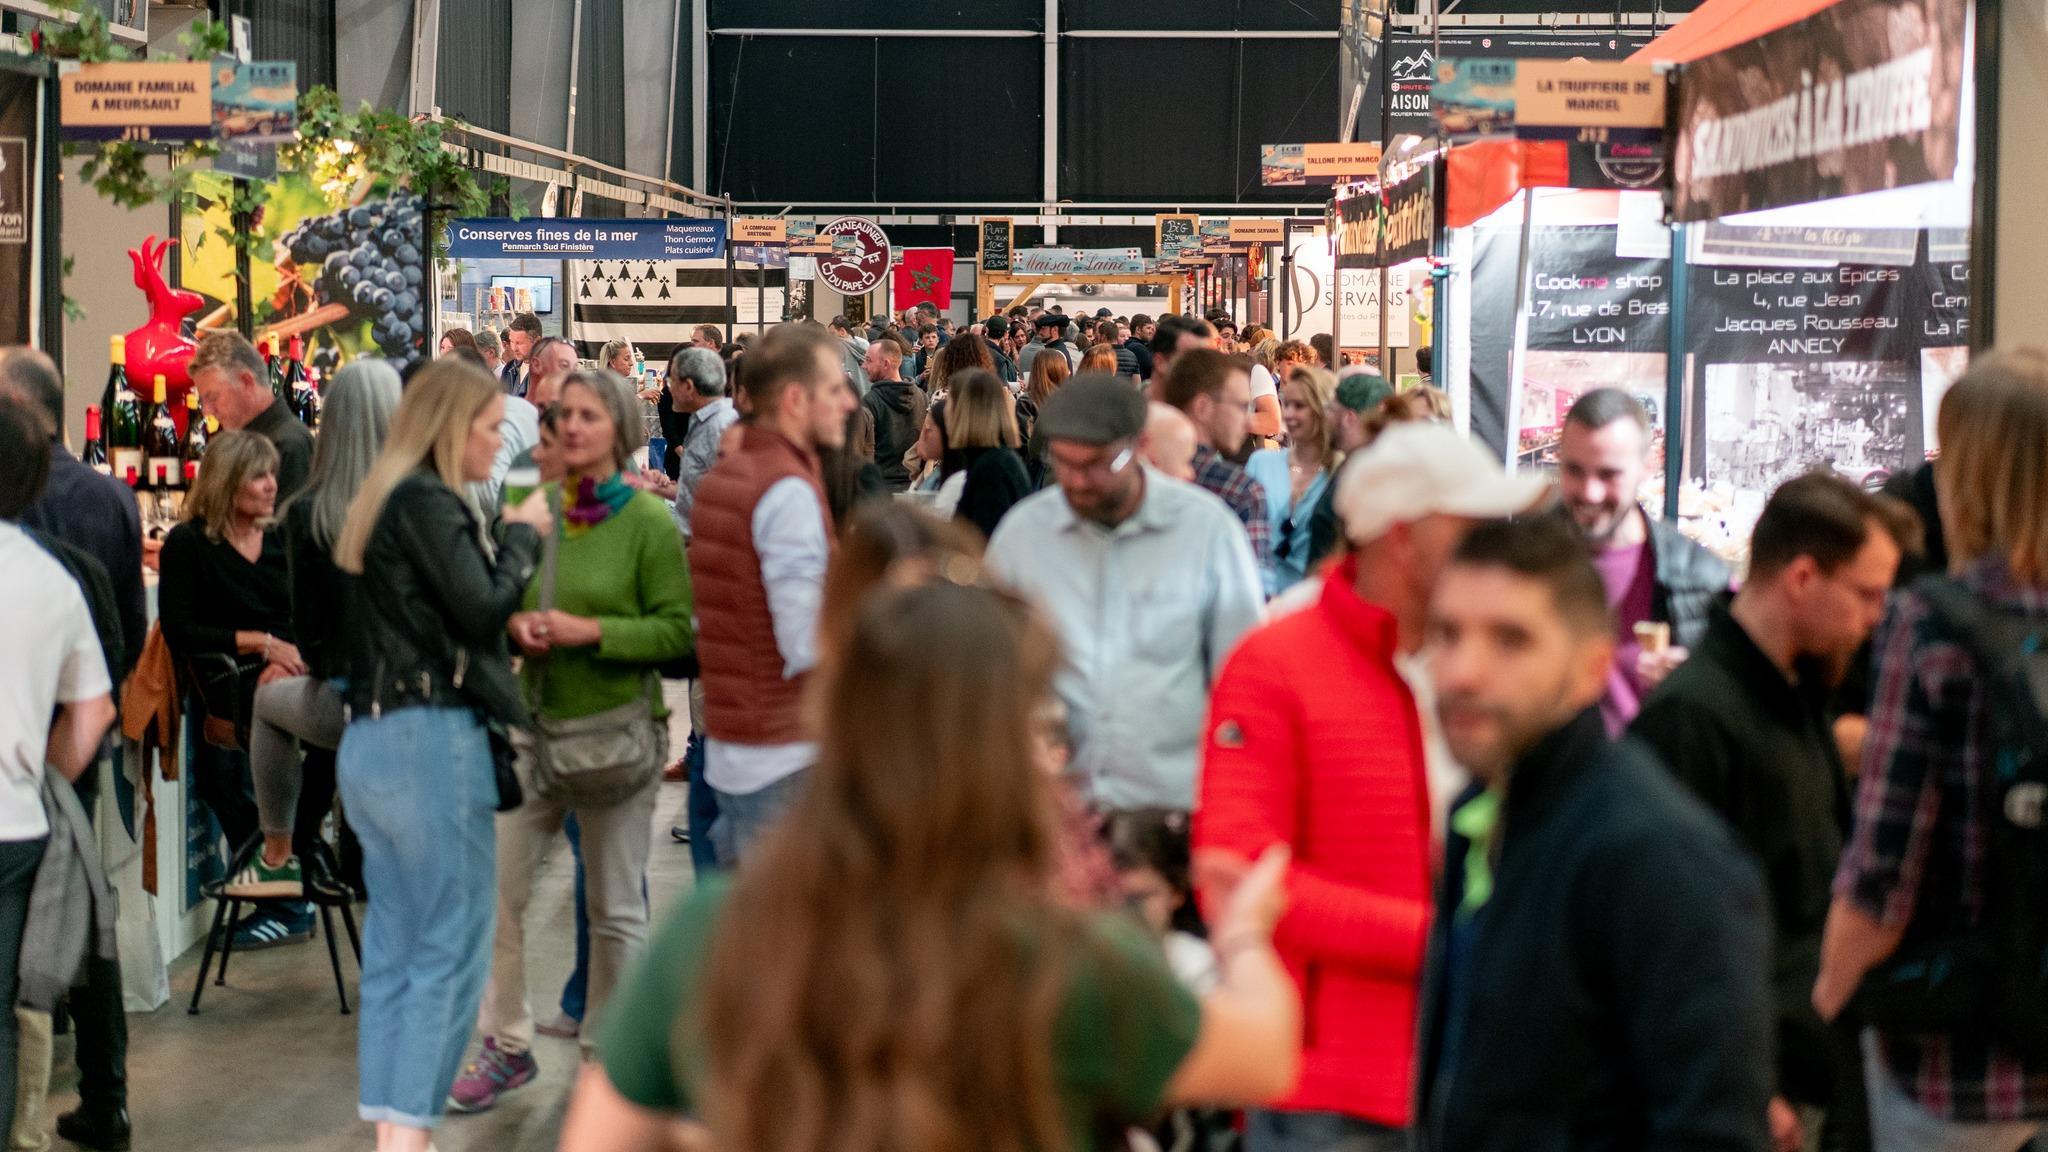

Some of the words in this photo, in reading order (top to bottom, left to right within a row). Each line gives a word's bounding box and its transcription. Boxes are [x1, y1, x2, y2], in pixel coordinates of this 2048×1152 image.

[74, 80, 133, 95] DOMAINE
[138, 81, 196, 94] FAMILIAL
[1537, 80, 1553, 93] LA
[1558, 80, 1628, 94] TRUFFIERE
[104, 98, 181, 112] MEURSAULT
[1565, 98, 1620, 112] MARCEL
[1813, 80, 1843, 155] LA
[1307, 157, 1336, 165] TALLONE
[459, 228, 533, 240] Conserves
[536, 228, 570, 241] fines
[574, 229, 591, 241] de
[595, 229, 607, 241] la
[611, 231, 638, 241] mer
[666, 225, 714, 233] Maquereaux
[829, 221, 886, 248] CHATEAUNEUF
[560, 242, 594, 251] Finistère
[664, 235, 683, 243] Thon
[685, 235, 716, 244] Germon
[665, 246, 683, 254] Plats
[685, 245, 714, 254] cuisinés
[828, 274, 842, 286] DU
[842, 281, 864, 290] PAPE
[1535, 273, 1609, 290] Cookme
[1615, 273, 1662, 291] shop
[1714, 271, 1740, 286] La
[1746, 270, 1795, 288] place
[1802, 271, 1833, 284] aux
[1839, 268, 1900, 286] Epices
[1778, 296, 1808, 308] rue
[1813, 292, 1861, 307] Jean
[1561, 304, 1592, 317] rue
[1598, 301, 1622, 315] de
[1714, 317, 1797, 335] Jacques
[1803, 315, 1899, 331] Rousseau
[1925, 320, 1950, 335] La
[1572, 327, 1626, 343] LYON
[1767, 338, 1846, 354] ANNECY
